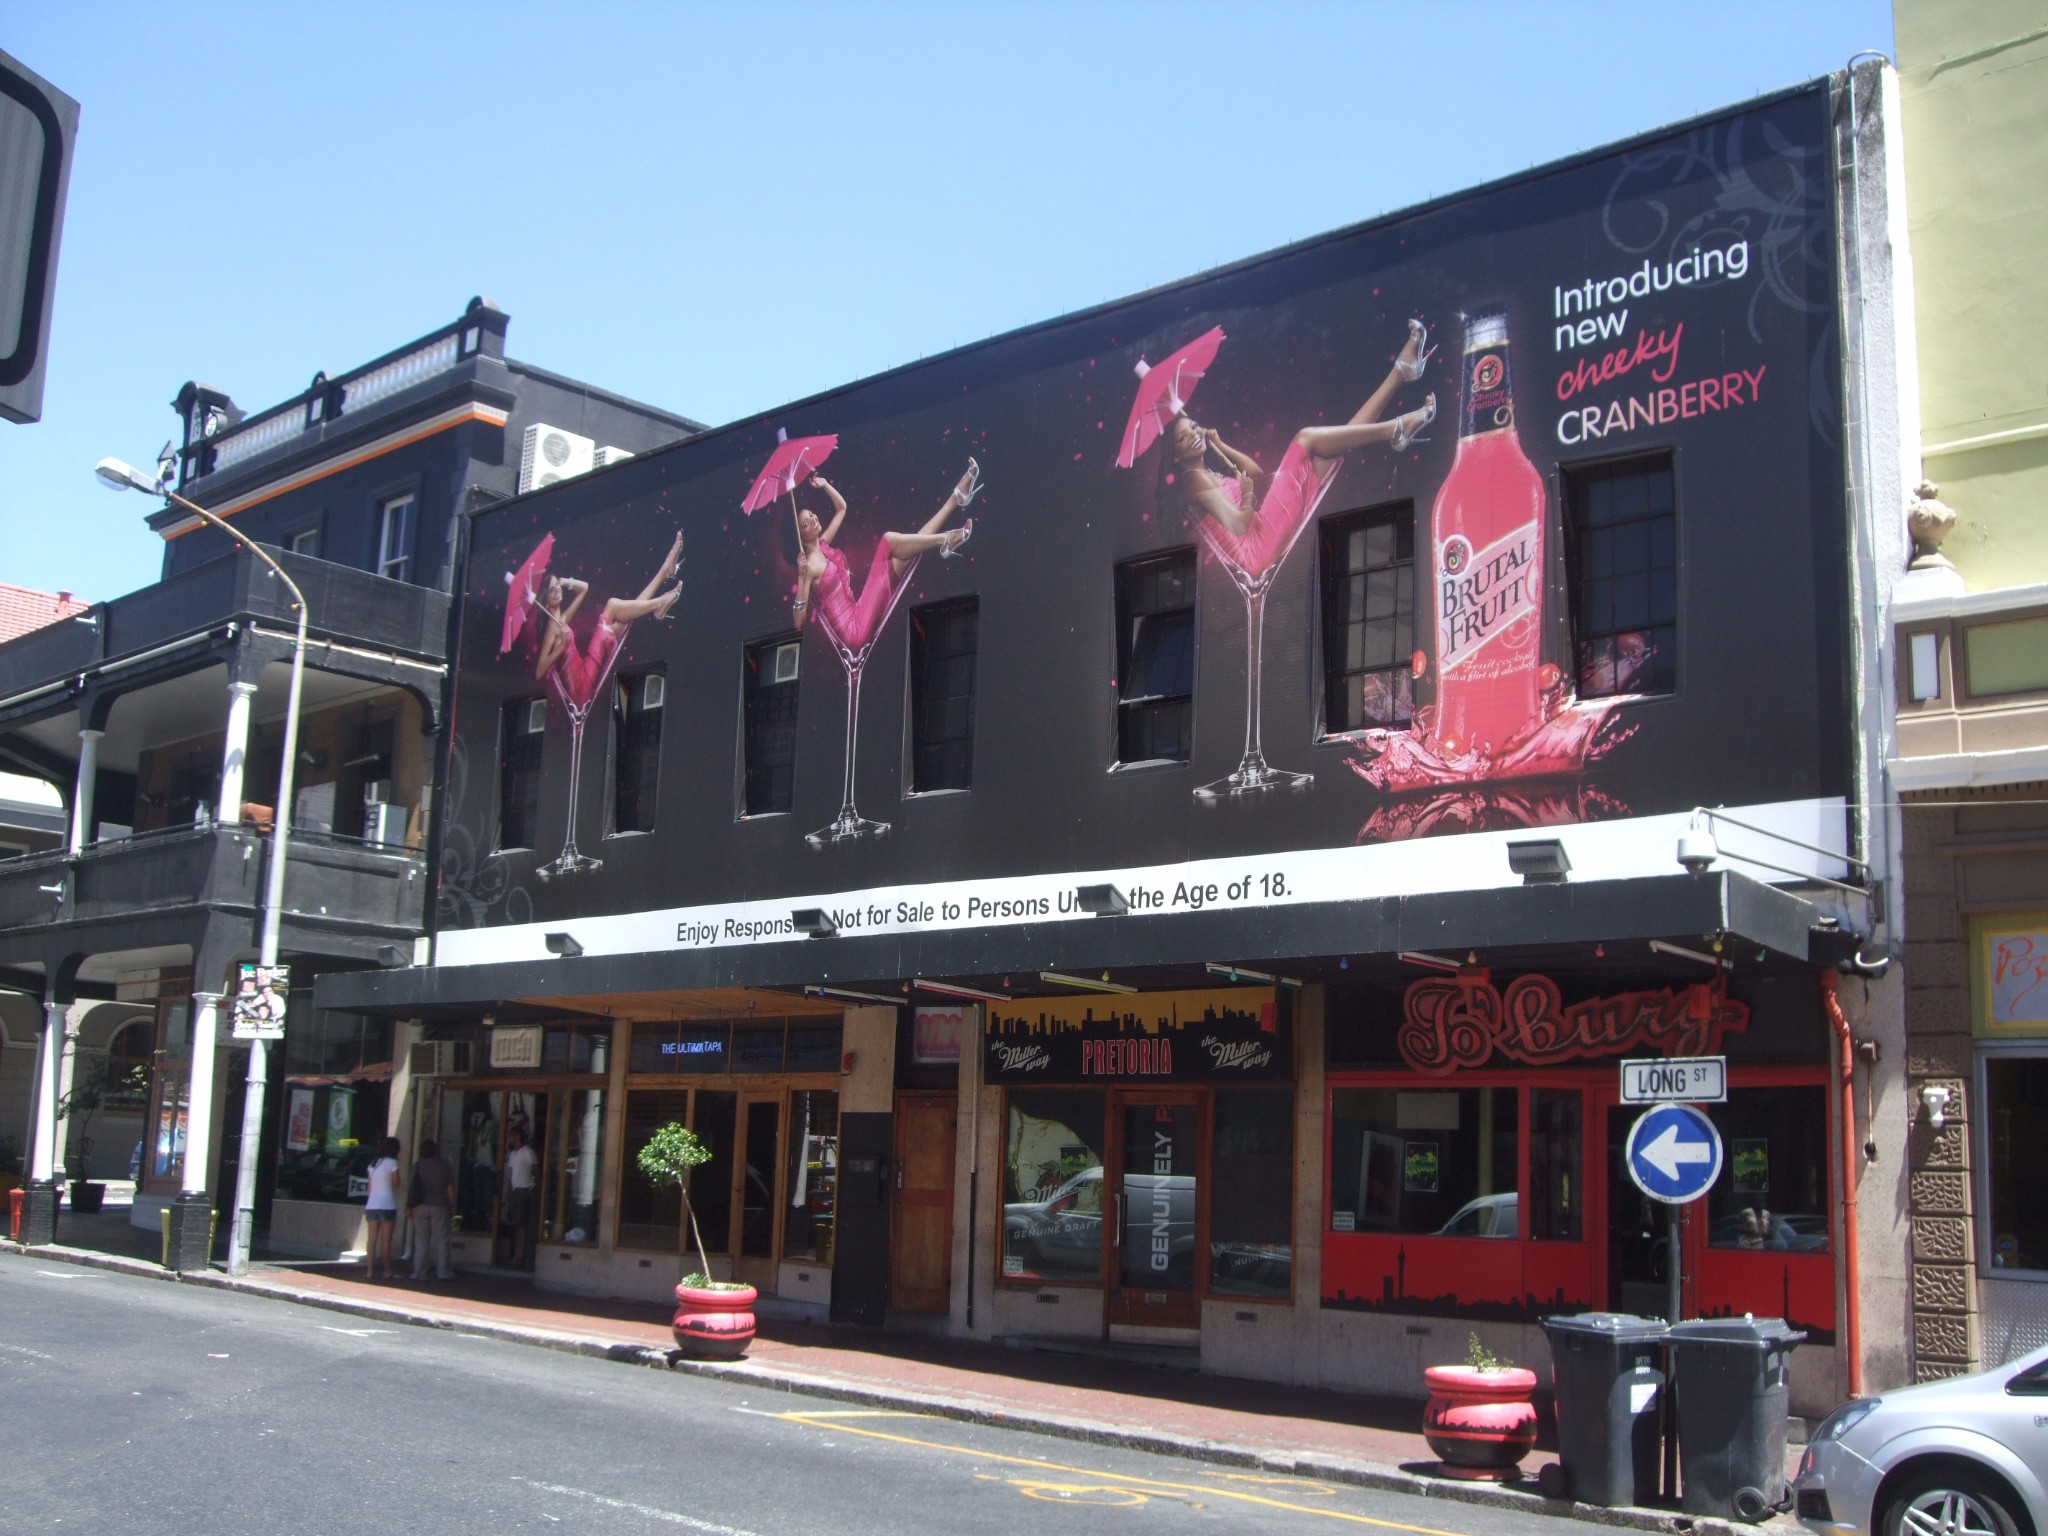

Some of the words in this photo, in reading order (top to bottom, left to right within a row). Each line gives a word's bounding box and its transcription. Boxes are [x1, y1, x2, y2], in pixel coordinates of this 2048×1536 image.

[1555, 241, 1748, 318] Introducing
[1556, 308, 1628, 351] new
[1557, 322, 1683, 400] cheeky
[1557, 365, 1766, 444] CRANBERRY
[1442, 539, 1532, 619] BRUTAL
[1449, 575, 1525, 655] FRUIT
[676, 921, 719, 943] Enjoy
[833, 909, 862, 930] Not
[867, 905, 891, 925] for
[896, 901, 934, 923] Sale
[941, 901, 961, 920] to
[967, 896, 1050, 918] Persons
[1129, 886, 1165, 909] the
[1172, 881, 1219, 909] Age
[1227, 875, 1251, 900] of
[1260, 872, 1292, 897] 18.
[661, 1043, 676, 1054] THE
[999, 1045, 1041, 1069] Miller
[1026, 1054, 1050, 1072] way
[1083, 1038, 1172, 1075] PRETORIA
[1210, 1041, 1261, 1067] Miller
[1242, 1051, 1271, 1070] way
[1637, 1068, 1686, 1094] LONG
[1694, 1068, 1708, 1083] ST
[1151, 1131, 1172, 1272] GENUINELY
[1013, 1225, 1060, 1240] GENUINE
[1064, 1220, 1098, 1233] DRAFT
